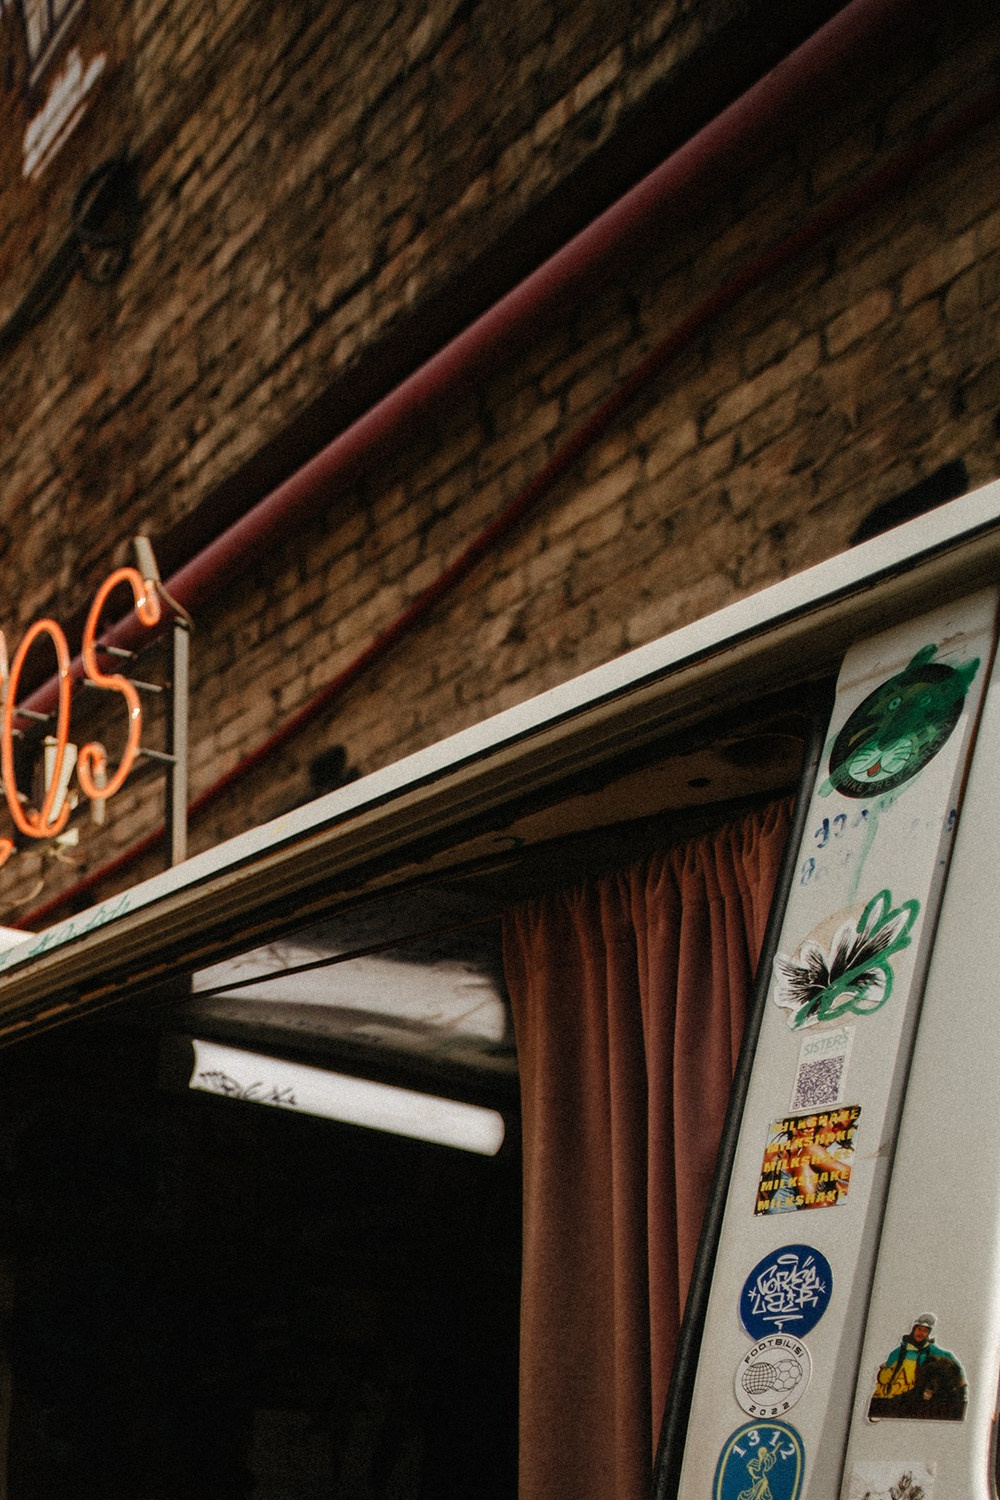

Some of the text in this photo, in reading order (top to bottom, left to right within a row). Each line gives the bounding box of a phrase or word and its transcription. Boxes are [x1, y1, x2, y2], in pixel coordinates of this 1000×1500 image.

[744, 1338, 804, 1364] FOOTBILISI
[748, 1401, 790, 1416] 2022
[732, 1430, 795, 1460] 1312
